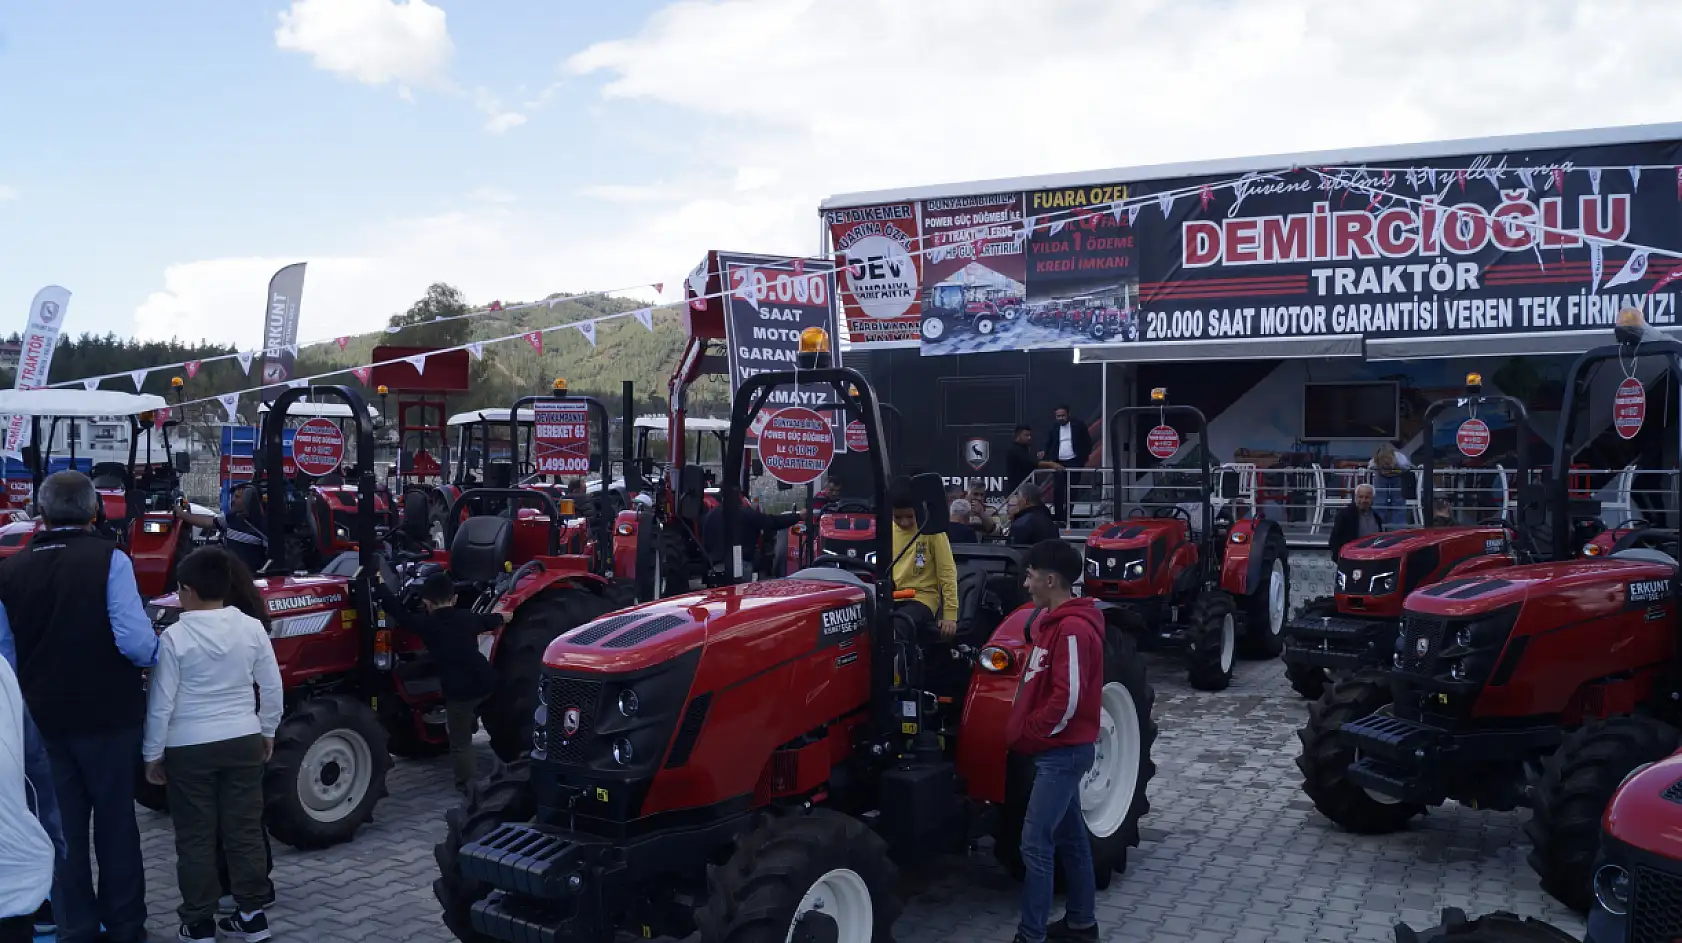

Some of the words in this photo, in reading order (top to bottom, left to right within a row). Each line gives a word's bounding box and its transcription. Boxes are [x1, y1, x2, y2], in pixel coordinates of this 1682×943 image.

[1033, 190, 1087, 208] FUARA
[925, 216, 953, 228] POWER
[954, 213, 972, 227] GÜÇ
[973, 209, 1009, 224] DÜĞMESİ
[839, 222, 881, 251] UARINA
[1180, 189, 1632, 270] DEMİRCİOĞLU
[1032, 241, 1069, 254] YILDA
[1072, 231, 1082, 251] 1
[1087, 235, 1135, 250] ÖDEME
[1037, 256, 1074, 272] KREDİ
[1311, 257, 1480, 296] TRAKTÖR
[267, 292, 288, 358] ERKUNT
[760, 307, 803, 322] SAAT
[1146, 307, 1203, 338] 20.000
[1207, 305, 1255, 336] SAAT
[1259, 302, 1327, 334] MOTOR
[1332, 293, 1439, 332] GARANTİSİ
[1445, 297, 1513, 329] VEREN
[1517, 296, 1562, 326] TEK
[753, 326, 801, 341] MOTO
[20, 334, 45, 382] TRAKTÖR
[538, 458, 588, 471] 1.499.000
[1629, 580, 1670, 597] ERKUNT
[268, 595, 312, 611] ERKUNT
[822, 604, 862, 628] ERKUNT
